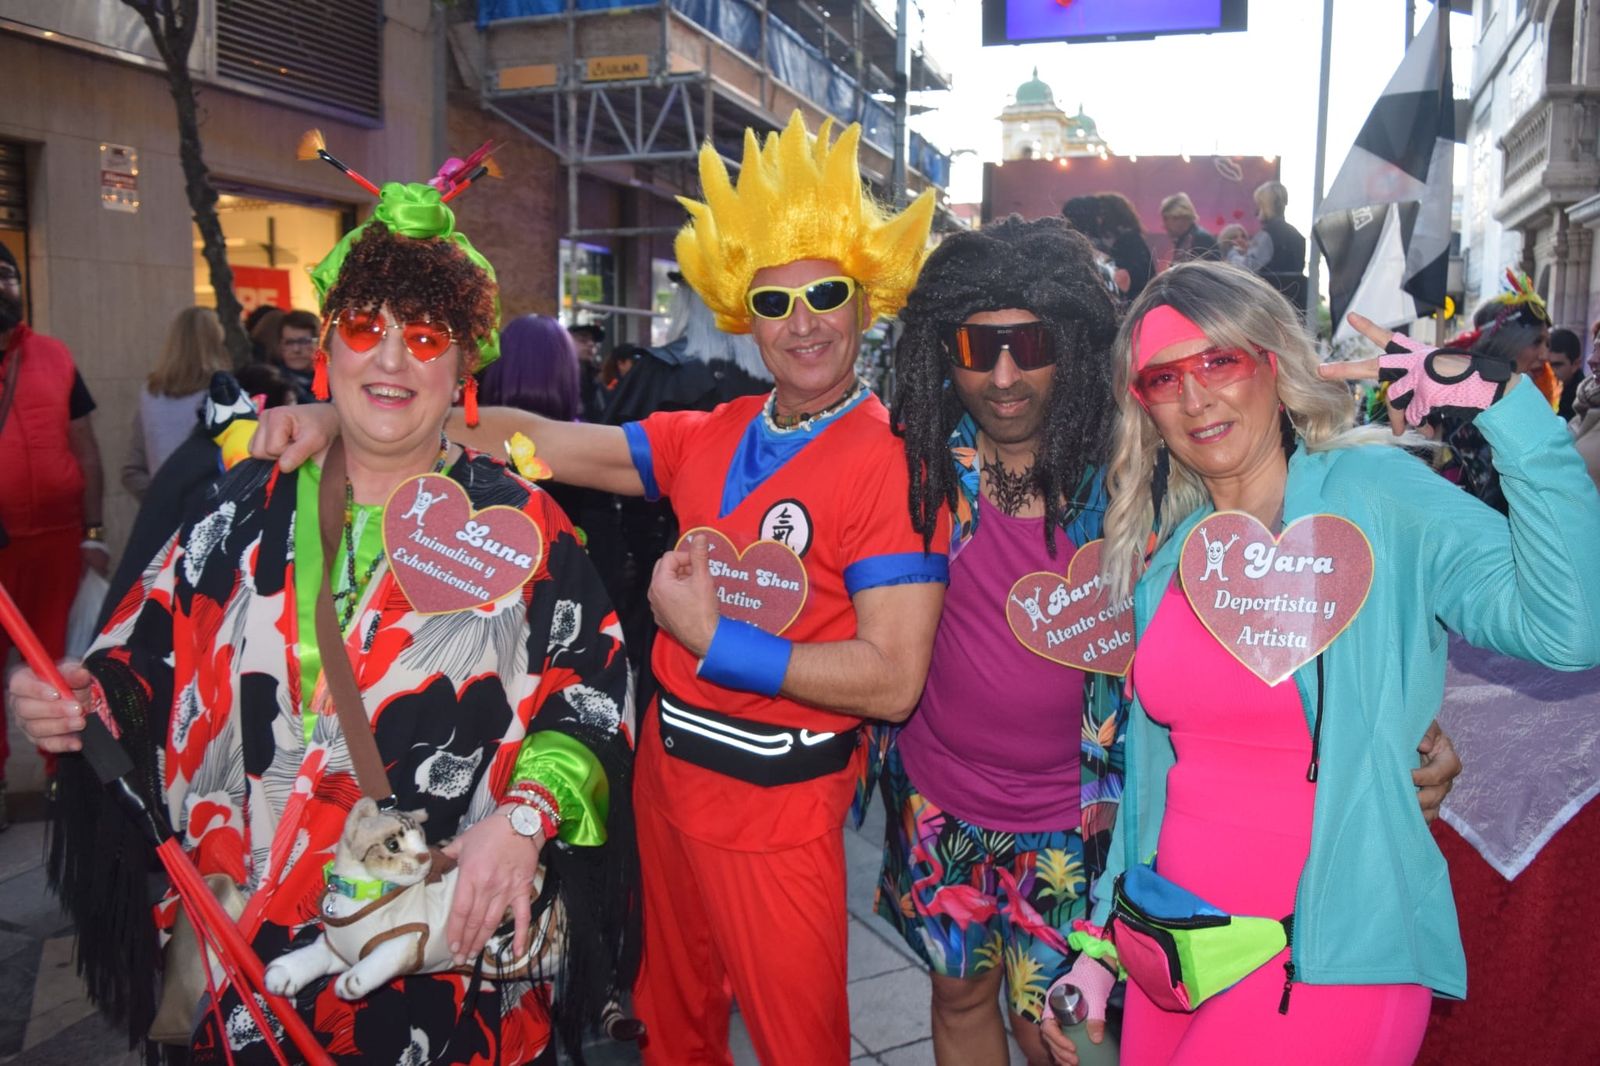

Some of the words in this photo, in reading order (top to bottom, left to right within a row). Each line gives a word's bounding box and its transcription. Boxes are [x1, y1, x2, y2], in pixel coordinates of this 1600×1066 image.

[408, 528, 485, 572] Animalista
[484, 565, 497, 579] y
[455, 520, 533, 569] Luna
[1243, 541, 1335, 579] Yara
[708, 559, 749, 581] Shon
[755, 568, 800, 592] Shon
[716, 586, 763, 610] Activo
[1213, 589, 1319, 615] Deportista
[1322, 600, 1336, 620] y
[1045, 615, 1097, 649] Atento
[1082, 643, 1099, 662] el
[1097, 629, 1132, 655] Solo
[1236, 625, 1308, 649] Artista
